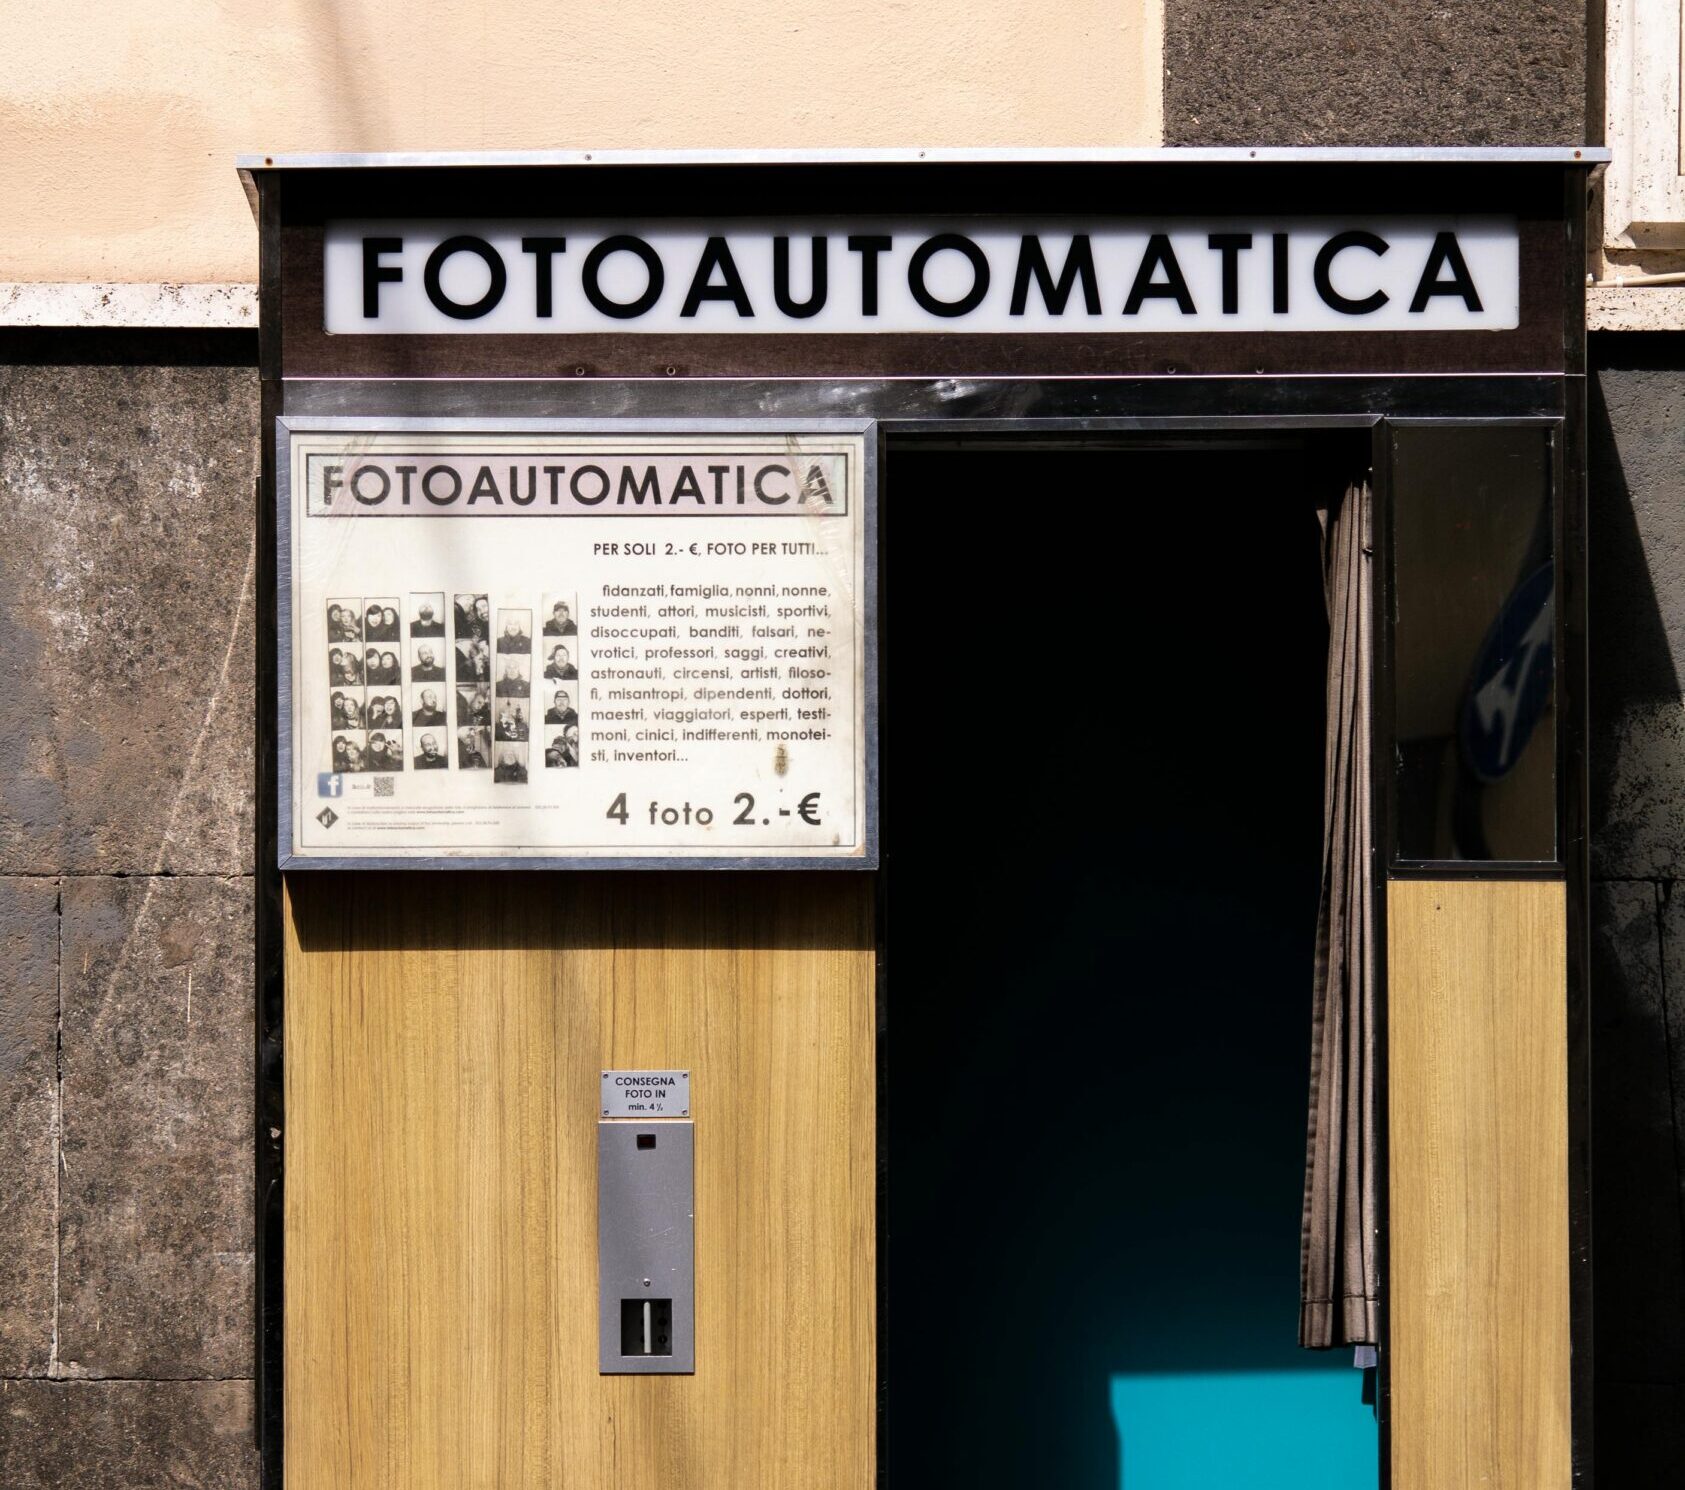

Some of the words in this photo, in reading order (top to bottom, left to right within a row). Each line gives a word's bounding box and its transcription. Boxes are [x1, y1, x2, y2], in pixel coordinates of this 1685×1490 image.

[361, 229, 1488, 320] FOTOAUTOMATICA
[324, 464, 834, 506] FOTOAUTOMATICA
[593, 542, 619, 556] PER
[624, 542, 656, 556] SOLI
[707, 542, 746, 556] FOTO
[752, 542, 776, 556] PER
[781, 542, 829, 556] TUTTI...
[602, 584, 669, 599] fidanzati,
[670, 584, 733, 599] famiglia,
[736, 584, 779, 599] nonni,
[782, 584, 831, 599] nonne,
[591, 605, 650, 619] studenti,
[658, 605, 698, 619] attori,
[705, 605, 770, 619] musicisti,
[777, 605, 832, 619] sportivi,
[591, 625, 680, 640] disoccupati,
[690, 625, 743, 640] banditi,
[752, 625, 798, 640] falsari,
[808, 627, 831, 637] ne-
[591, 646, 638, 661] vrotici,
[645, 646, 718, 661] professori,
[724, 646, 768, 661] saggi,
[774, 646, 832, 661] creativi,
[591, 667, 666, 681] astronauti,
[673, 667, 733, 681] circensi,
[741, 667, 781, 681] artisti,
[789, 667, 831, 681] filoso-
[591, 687, 602, 702] fi,
[609, 687, 687, 702] misantropi,
[694, 687, 776, 702] dipendenti,
[782, 687, 832, 702] dottori,
[591, 708, 647, 723] maestri,
[654, 708, 734, 723] viaggiatori,
[740, 708, 792, 723] esperti,
[797, 708, 831, 723] testi-
[591, 729, 630, 742] moni,
[636, 729, 678, 742] cinici,
[683, 729, 762, 742] indifferenti,
[767, 728, 831, 741] monotei-
[591, 749, 609, 763] sti,
[614, 749, 688, 763] inventori...
[606, 792, 629, 826] 4
[649, 800, 713, 826] foto
[615, 1077, 675, 1086] CONSEGNA
[625, 1089, 652, 1098] FOTO
[655, 1089, 666, 1098] IN
[628, 1102, 647, 1111] min.
